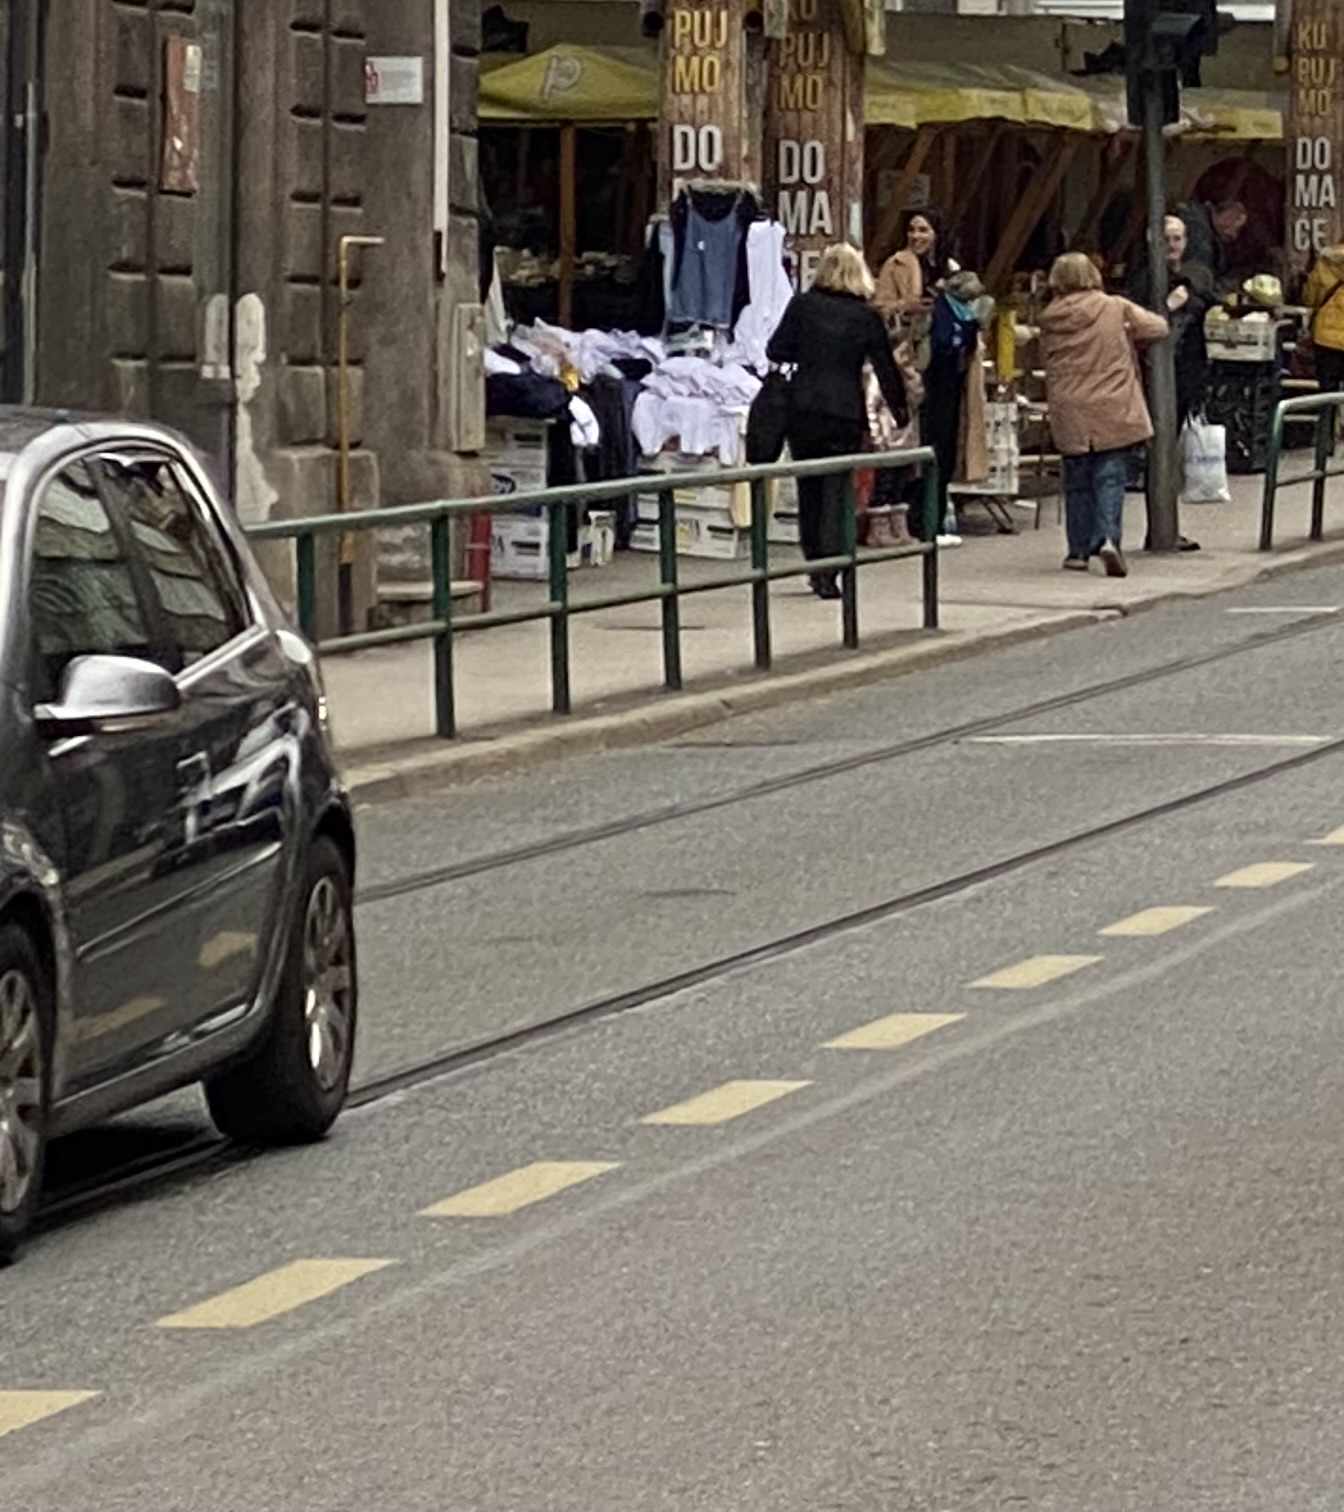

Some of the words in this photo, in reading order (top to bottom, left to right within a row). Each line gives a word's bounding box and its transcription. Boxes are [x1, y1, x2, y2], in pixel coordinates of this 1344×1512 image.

[673, 10, 728, 48] PUJ
[1299, 24, 1326, 51] KU
[779, 32, 830, 68] PUJ
[673, 55, 721, 93] MO
[1299, 57, 1336, 85] PUJ
[779, 74, 823, 111] MO
[1299, 90, 1332, 116] MO
[672, 124, 723, 171] DO
[779, 140, 826, 185] DO
[1296, 137, 1332, 171] DO
[1295, 175, 1336, 208] MA
[778, 190, 833, 236] MA
